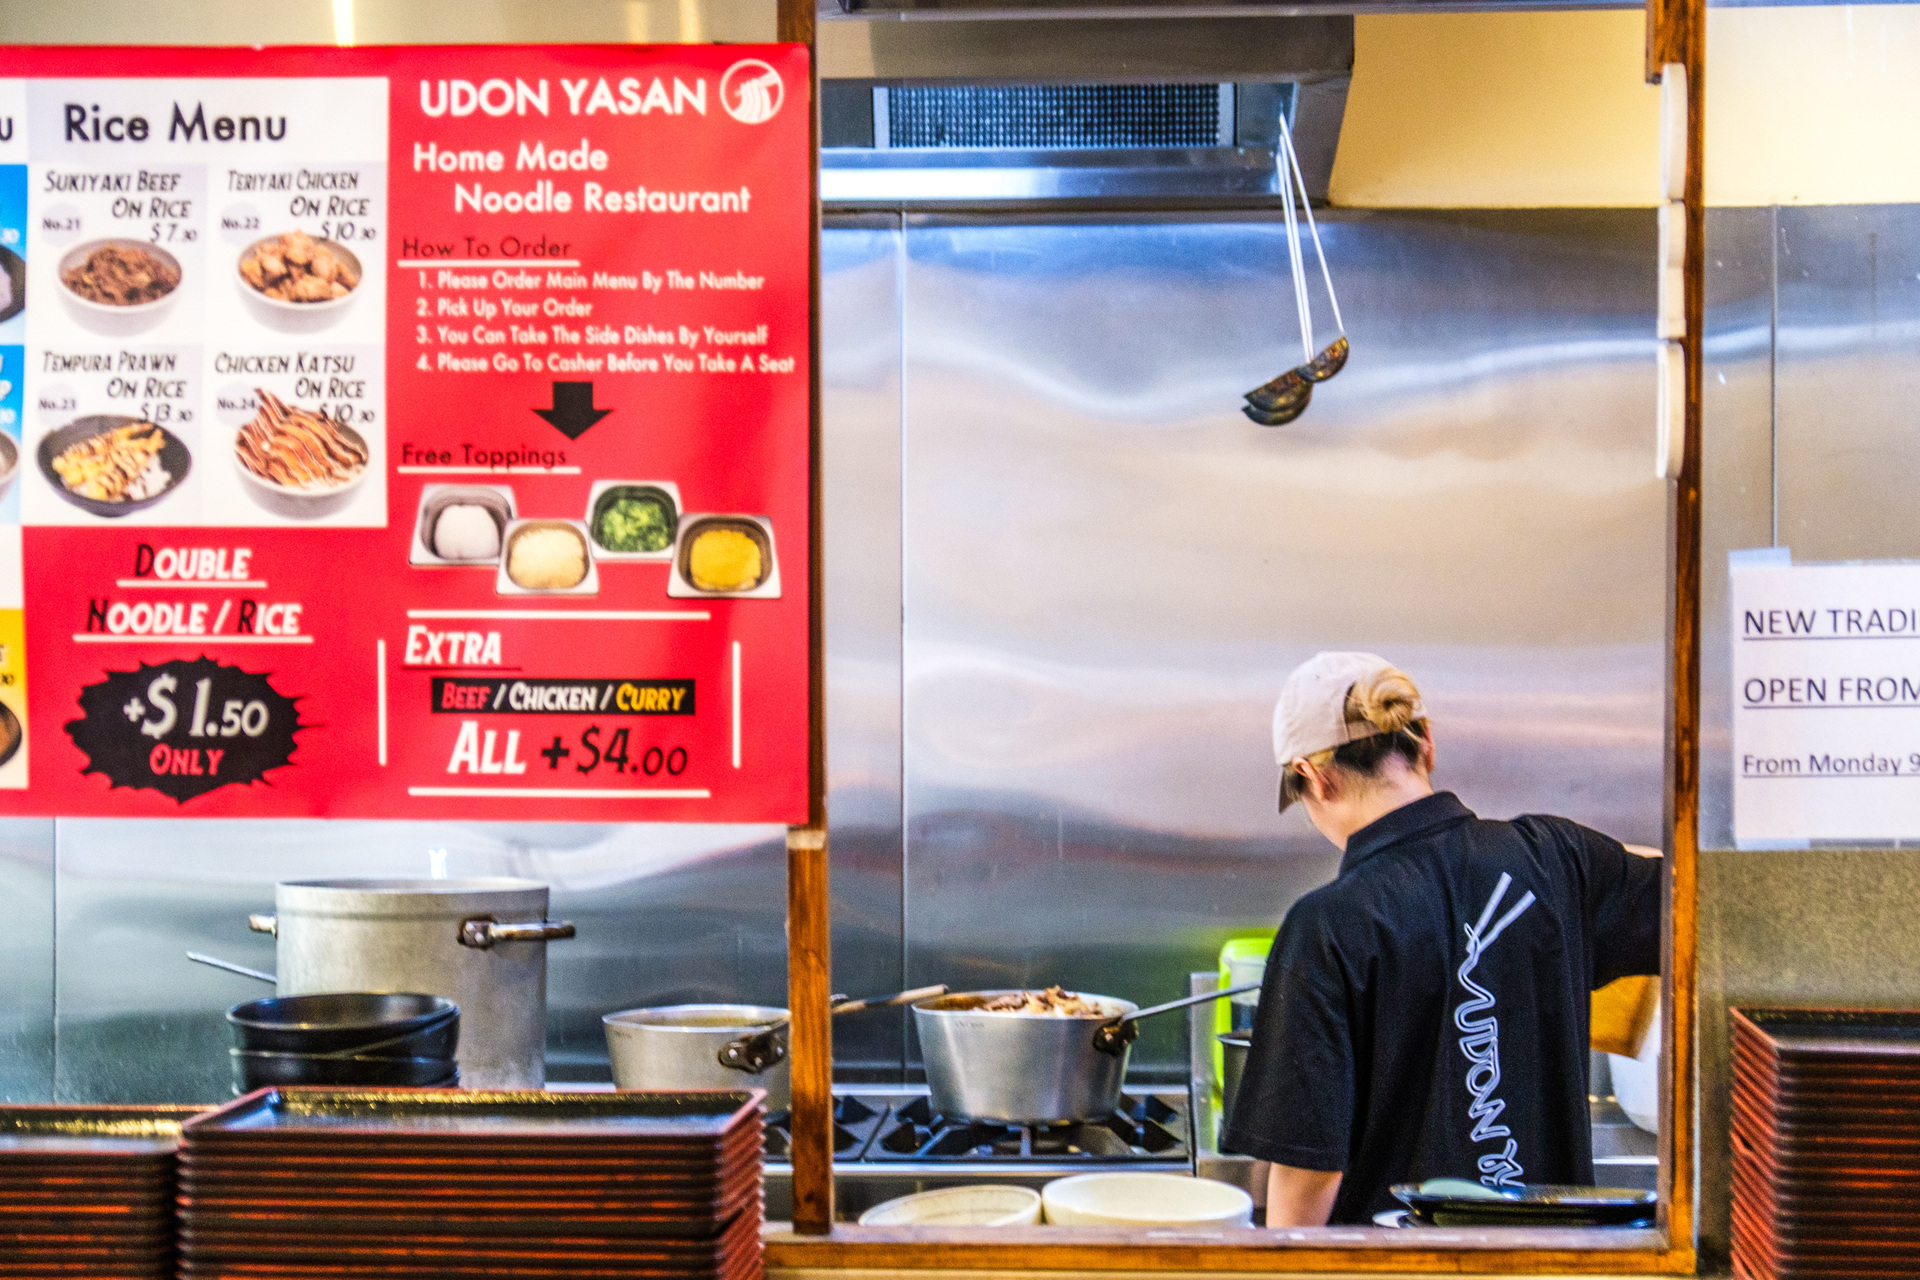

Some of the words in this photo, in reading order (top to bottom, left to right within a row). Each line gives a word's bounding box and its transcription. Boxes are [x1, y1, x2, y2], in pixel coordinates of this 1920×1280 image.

[419, 77, 549, 117] UDON
[560, 76, 706, 116] YASAN
[64, 102, 149, 142] Rice
[168, 99, 286, 142] Menu
[413, 142, 504, 172] Home
[516, 138, 609, 171] Made
[44, 170, 131, 193] SUKIYAKI
[137, 170, 181, 192] BEEF
[227, 170, 292, 191] TERIYAKI
[296, 169, 358, 190] CHICKEN
[112, 198, 142, 219] ON
[149, 198, 191, 219] RICE
[290, 196, 320, 217] ON
[326, 196, 369, 217] RICE
[455, 180, 572, 213] Noodle
[584, 181, 751, 213] Restaurant
[402, 237, 454, 257] How
[466, 237, 490, 256] To
[500, 235, 570, 257] Order
[419, 270, 432, 289] 1.
[437, 269, 488, 289] Please
[492, 269, 541, 289] Order
[546, 270, 588, 289] Main
[592, 270, 638, 289] Menu
[642, 270, 662, 295] By
[666, 269, 695, 289] The
[700, 269, 765, 290] Number
[416, 297, 432, 317] 2.
[437, 296, 468, 317] Pick
[473, 297, 497, 321] Up
[501, 297, 539, 317] Your
[543, 296, 593, 317] Order
[416, 324, 432, 344] 3.
[437, 325, 468, 344] You
[472, 325, 506, 344] Can
[509, 324, 548, 344] Take
[551, 324, 580, 344] The
[585, 324, 619, 344] Side
[624, 324, 674, 344] Dishes
[679, 325, 699, 349] By
[703, 324, 768, 345] Yourself
[43, 351, 111, 372] TEMPURA
[118, 350, 176, 372] PRAWN
[215, 352, 288, 374] CHICKEN
[295, 351, 356, 374] KATSU
[416, 353, 432, 371] 4.
[437, 352, 488, 371] Please
[493, 353, 519, 372] Go
[523, 353, 543, 371] To
[547, 352, 602, 372] Casher
[608, 351, 658, 372] Before
[663, 353, 694, 372] You
[698, 352, 736, 372] Take
[740, 354, 755, 371] A
[759, 353, 795, 372] Seat
[107, 377, 137, 398] ON
[144, 377, 187, 398] RICE
[295, 377, 322, 398] ON
[329, 377, 366, 398] RICE
[402, 445, 452, 464] Free
[462, 444, 566, 472] Toppings
[134, 543, 252, 580] DOUBLE
[87, 598, 208, 635] NOODLE
[237, 599, 303, 635] RICE
[1744, 609, 1816, 634] NEW
[1826, 608, 1916, 633] TRADI
[404, 625, 501, 666] EXTRA
[1744, 677, 1826, 703] OPEN
[1839, 677, 1920, 702] FROM
[150, 744, 225, 776] ONLY
[446, 721, 526, 775] ALL
[1743, 754, 1800, 774] From
[1809, 753, 1901, 776] Monday
[1454, 998, 1511, 1142] UDON
